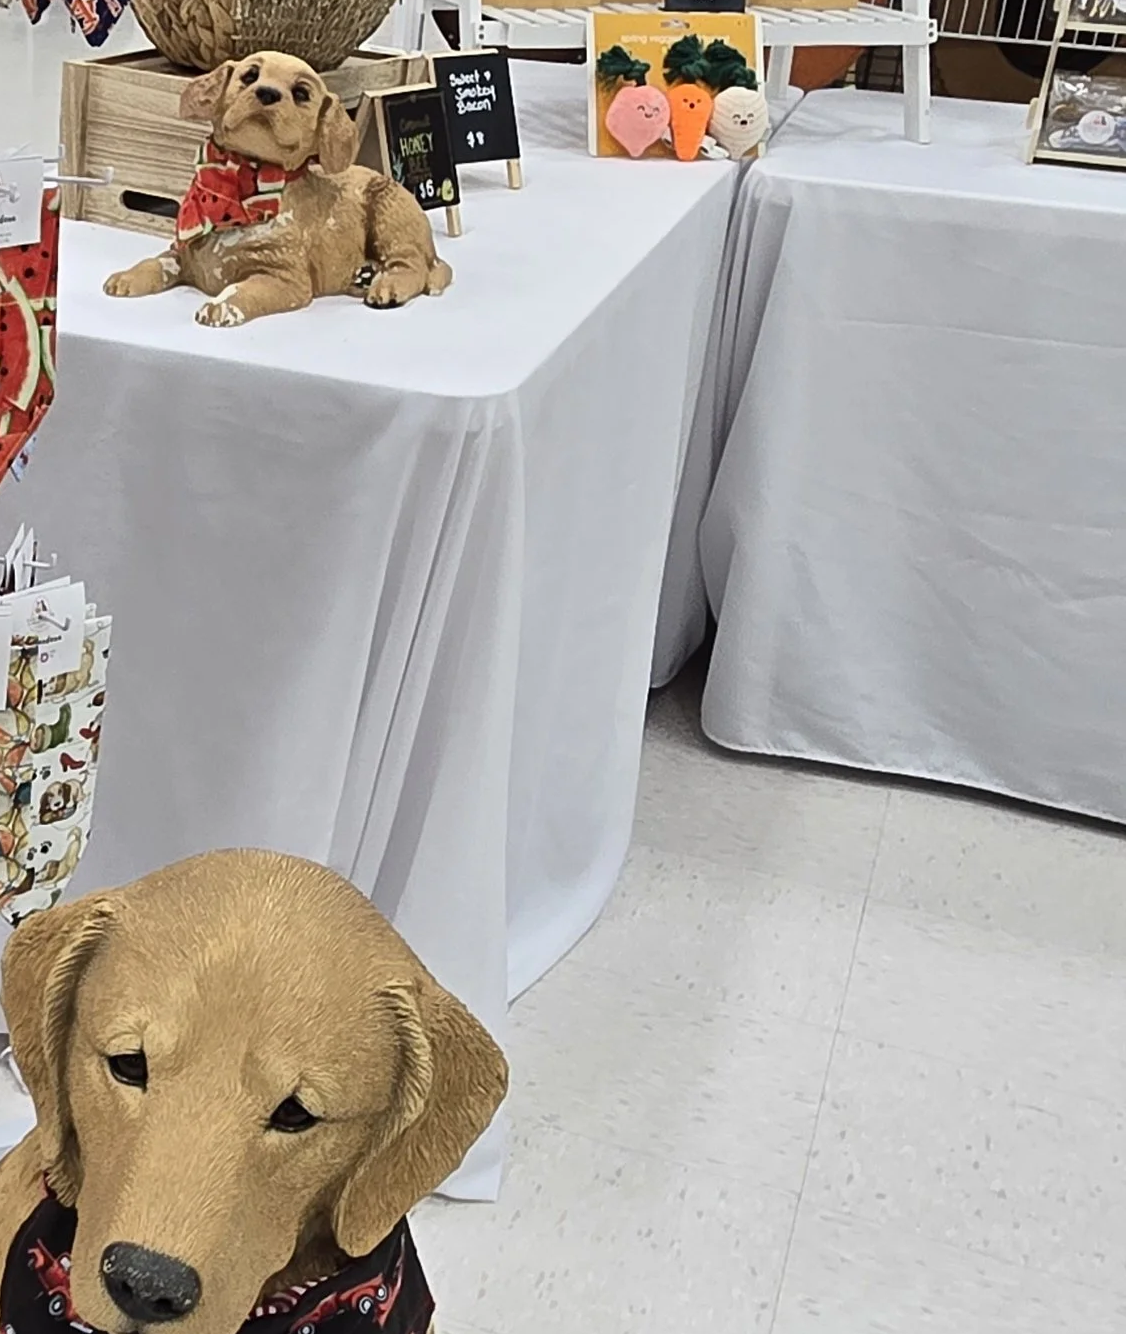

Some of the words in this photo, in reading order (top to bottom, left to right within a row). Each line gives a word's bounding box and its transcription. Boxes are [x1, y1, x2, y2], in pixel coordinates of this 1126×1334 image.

[449, 69, 480, 88] Sweet
[456, 98, 492, 115] Bacon
[399, 132, 434, 158] HONEY
[466, 131, 485, 149] $8
[419, 178, 435, 199] $6
